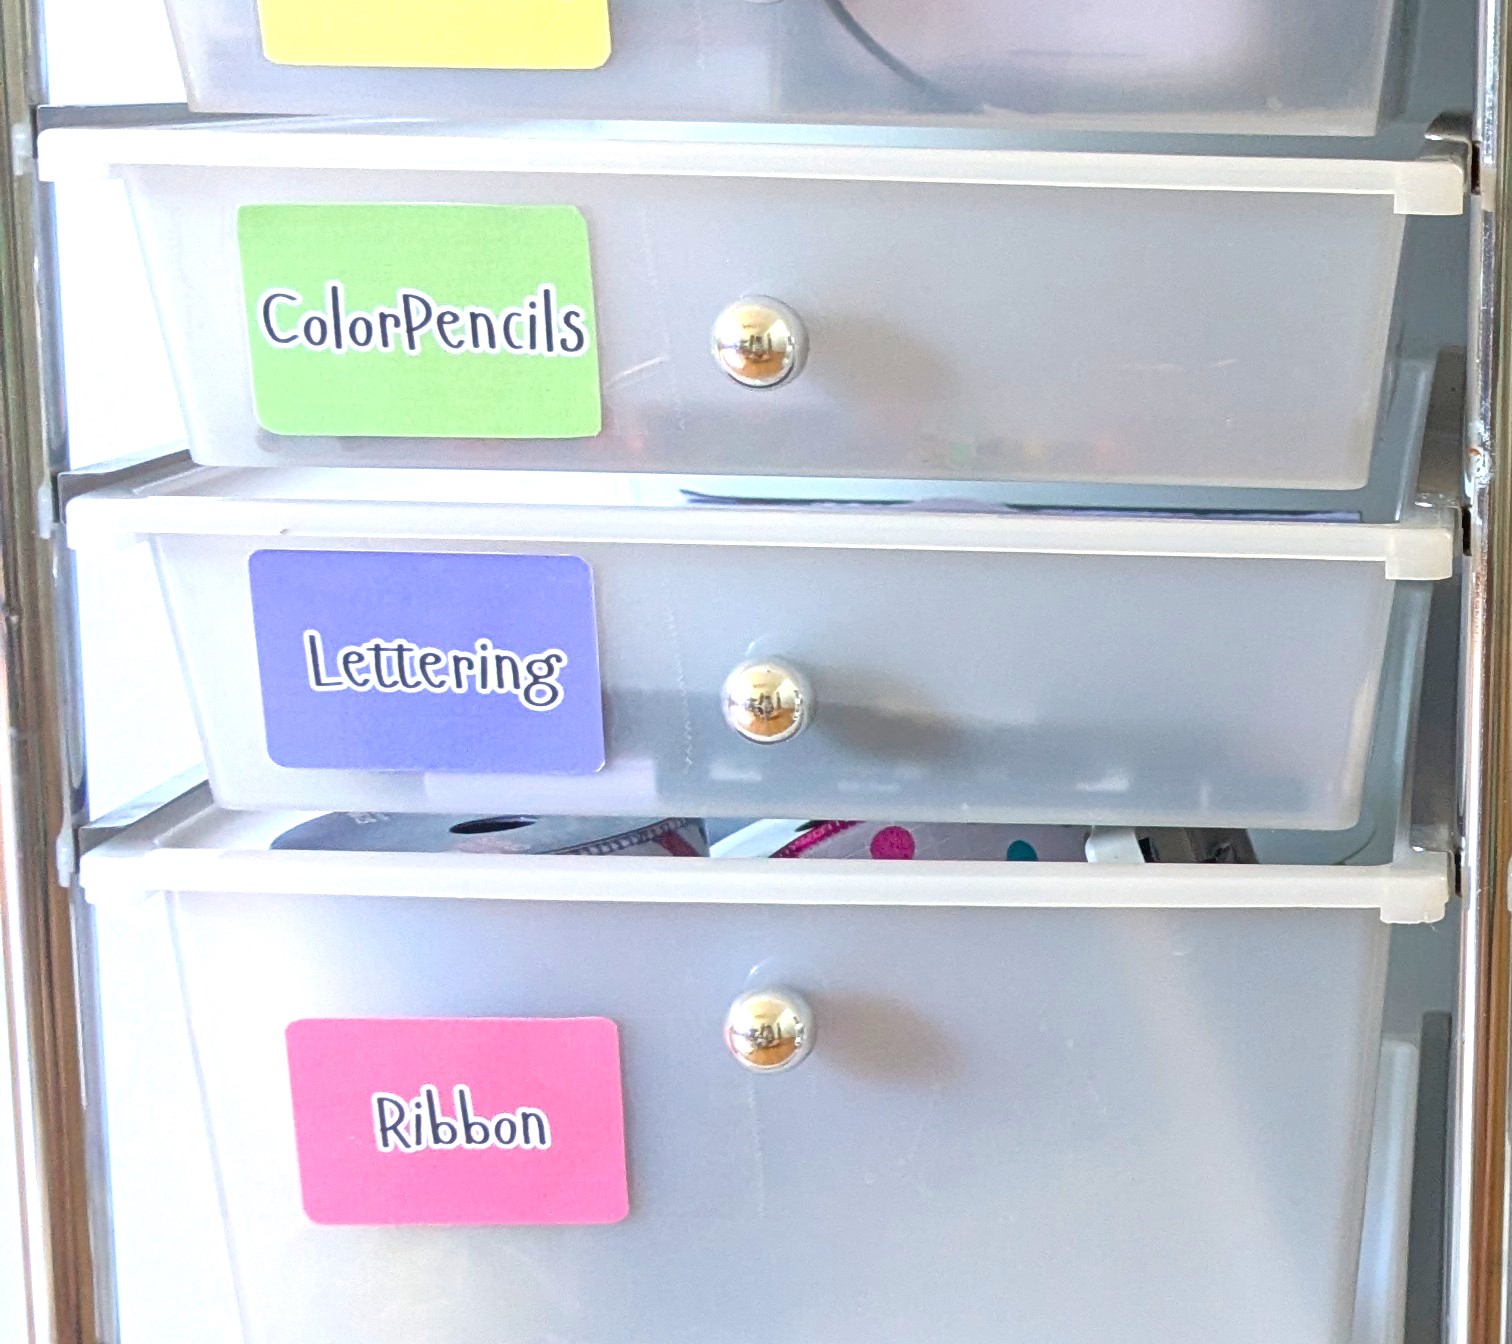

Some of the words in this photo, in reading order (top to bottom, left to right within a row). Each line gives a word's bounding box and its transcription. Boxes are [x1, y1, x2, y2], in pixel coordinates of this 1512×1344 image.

[262, 285, 585, 353] ColorPencils
[308, 634, 563, 708] Lettering
[375, 1088, 548, 1149] Ribbon
